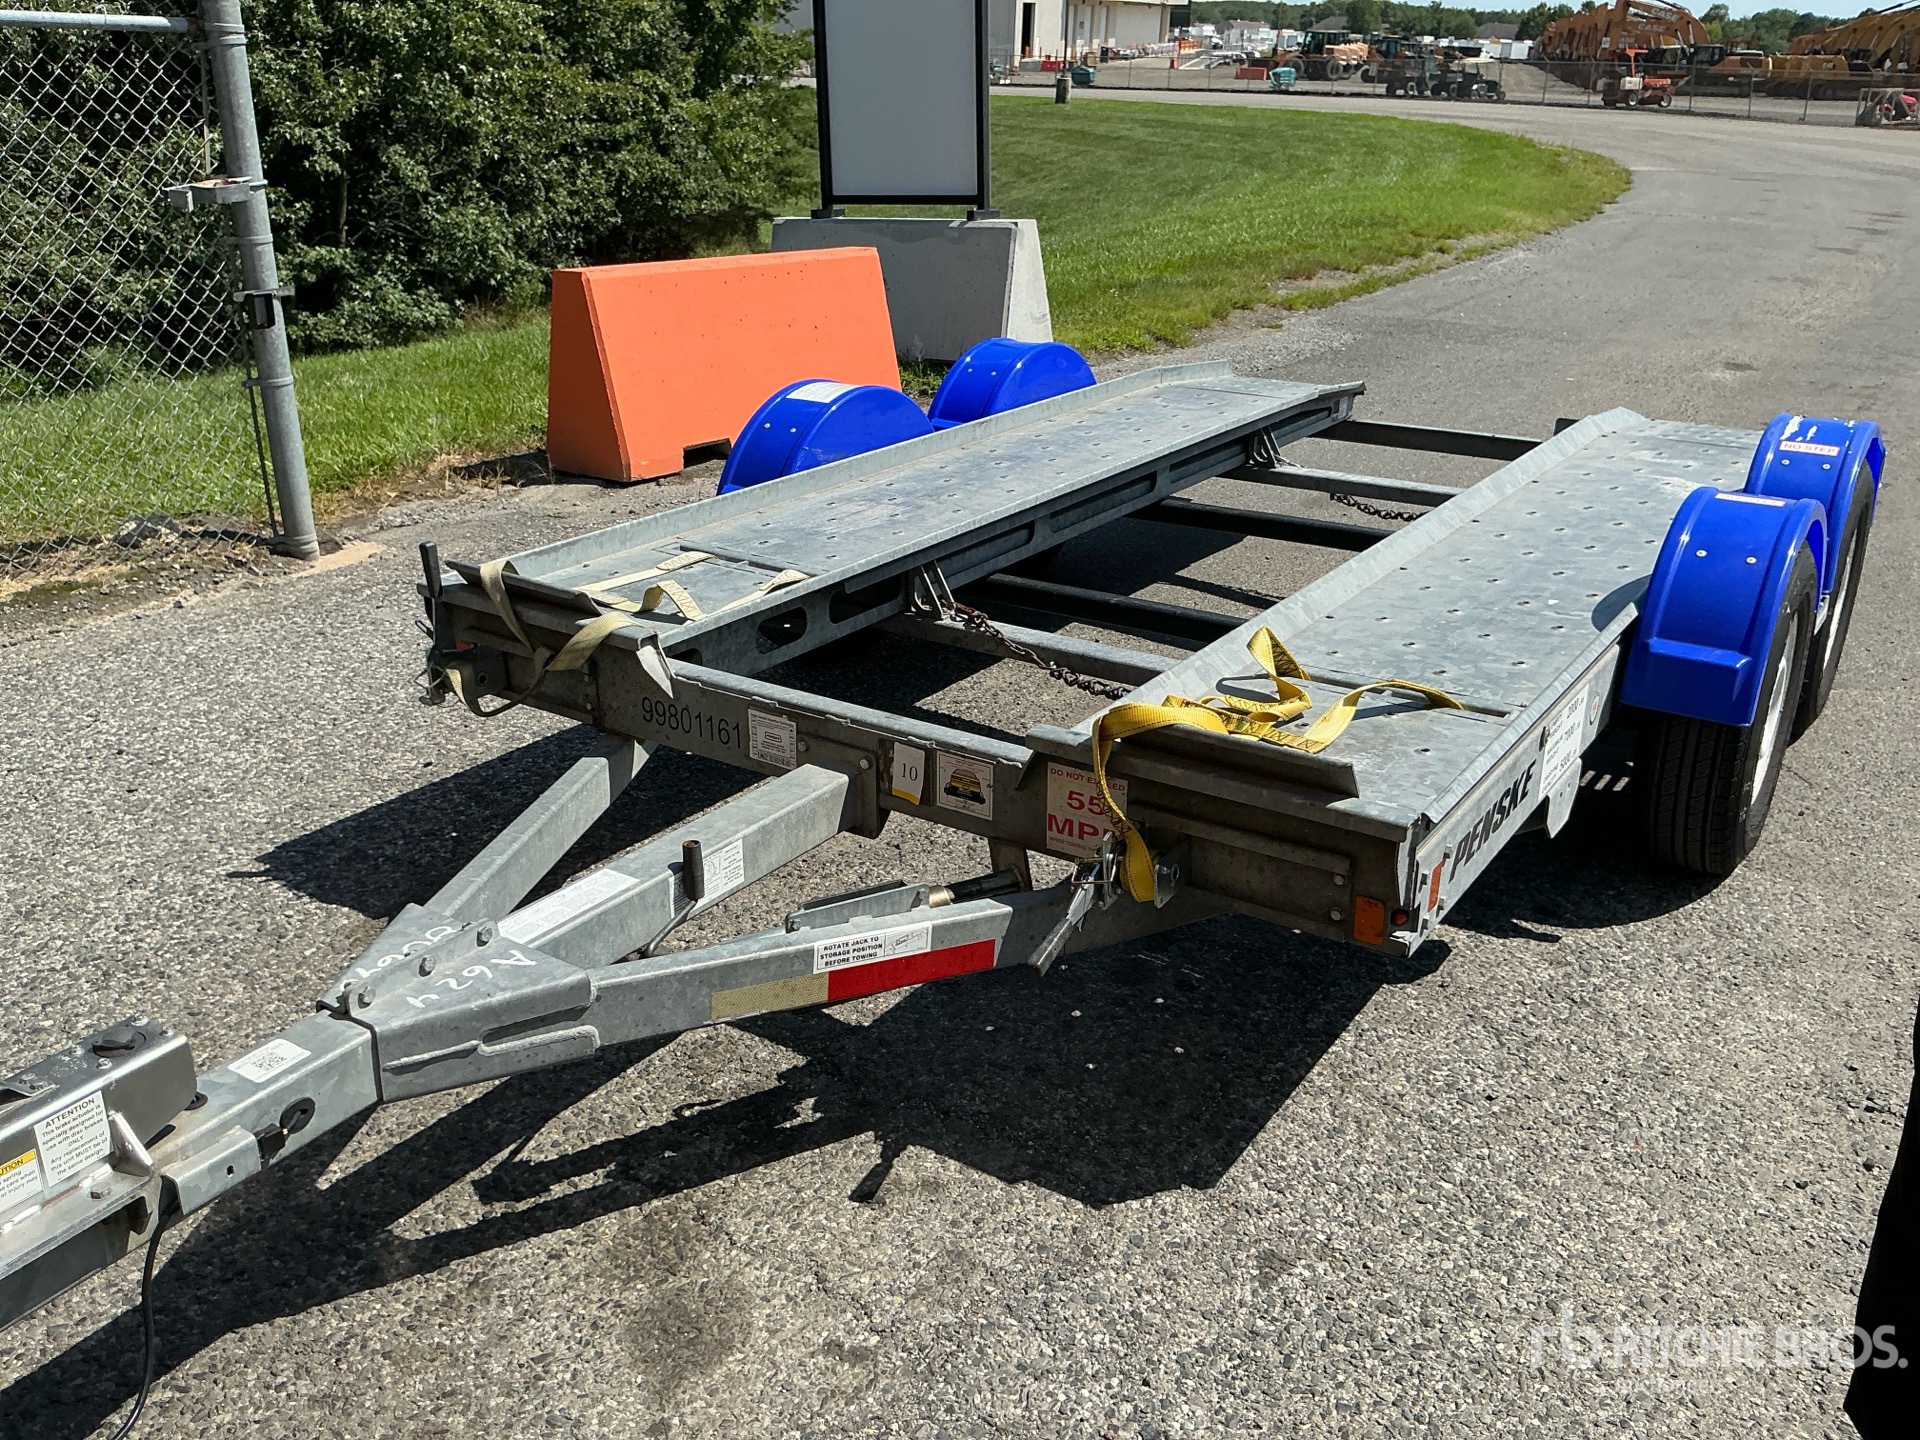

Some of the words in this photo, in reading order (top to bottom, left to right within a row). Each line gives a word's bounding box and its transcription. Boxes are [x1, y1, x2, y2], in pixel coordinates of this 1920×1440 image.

[1651, 7, 1680, 22] CASE
[1638, 23, 1666, 32] CASE
[1803, 445, 1835, 454] STEP
[642, 696, 742, 750] 99801161
[900, 762, 918, 782] 10
[1051, 767, 1064, 777] DO
[1066, 769, 1084, 781] NOT
[1087, 776, 1126, 792] EXEED
[1066, 790, 1105, 816] 55
[1448, 758, 1537, 885] PENSKE
[1048, 836, 1065, 845] WHEN
[820, 949, 850, 960] STORAGE
[852, 943, 883, 953] POSITION
[823, 942, 849, 952] ROTATE
[851, 938, 869, 947] JACK
[824, 957, 850, 967] BEFORE
[852, 951, 878, 962] TOWING
[45, 1097, 95, 1129] ATTENTION
[42, 1128, 54, 1138] This
[56, 1119, 71, 1131] brake
[71, 1107, 95, 1122] actuator
[69, 1113, 95, 1132] designed
[85, 1117, 103, 1132] brakes
[50, 1155, 62, 1165] Any
[63, 1137, 99, 1158] replacement
[76, 1146, 93, 1158] MUST
